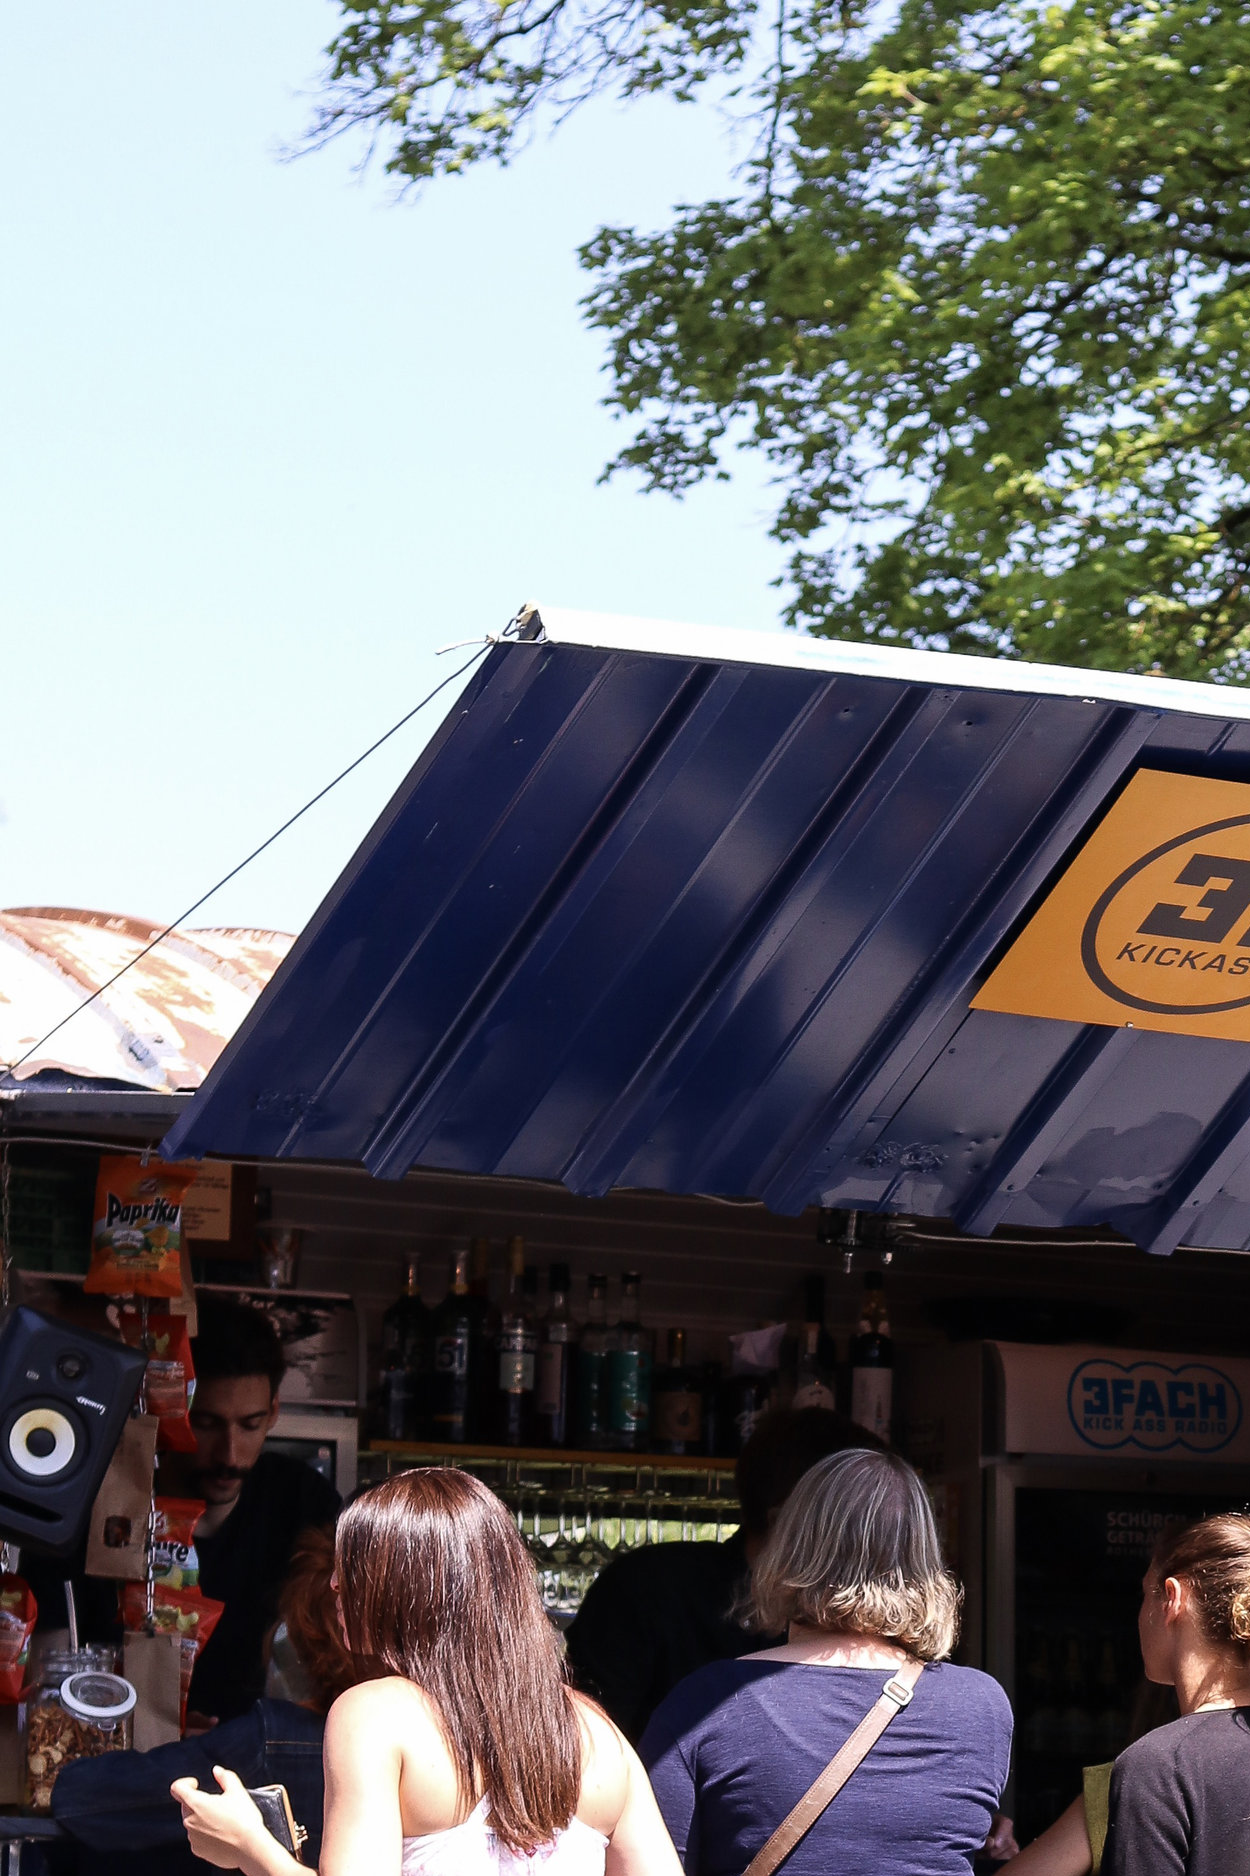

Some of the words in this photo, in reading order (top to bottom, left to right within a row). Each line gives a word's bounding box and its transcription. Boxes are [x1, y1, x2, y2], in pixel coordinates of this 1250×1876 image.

[106, 1191, 182, 1227] Paprika
[1083, 1378, 1228, 1420] 3FACH
[1083, 1417, 1124, 1431] KICK
[1133, 1418, 1166, 1433] ASS
[1175, 1419, 1228, 1435] RADIO
[1106, 1509, 1187, 1528] SCHÜRC
